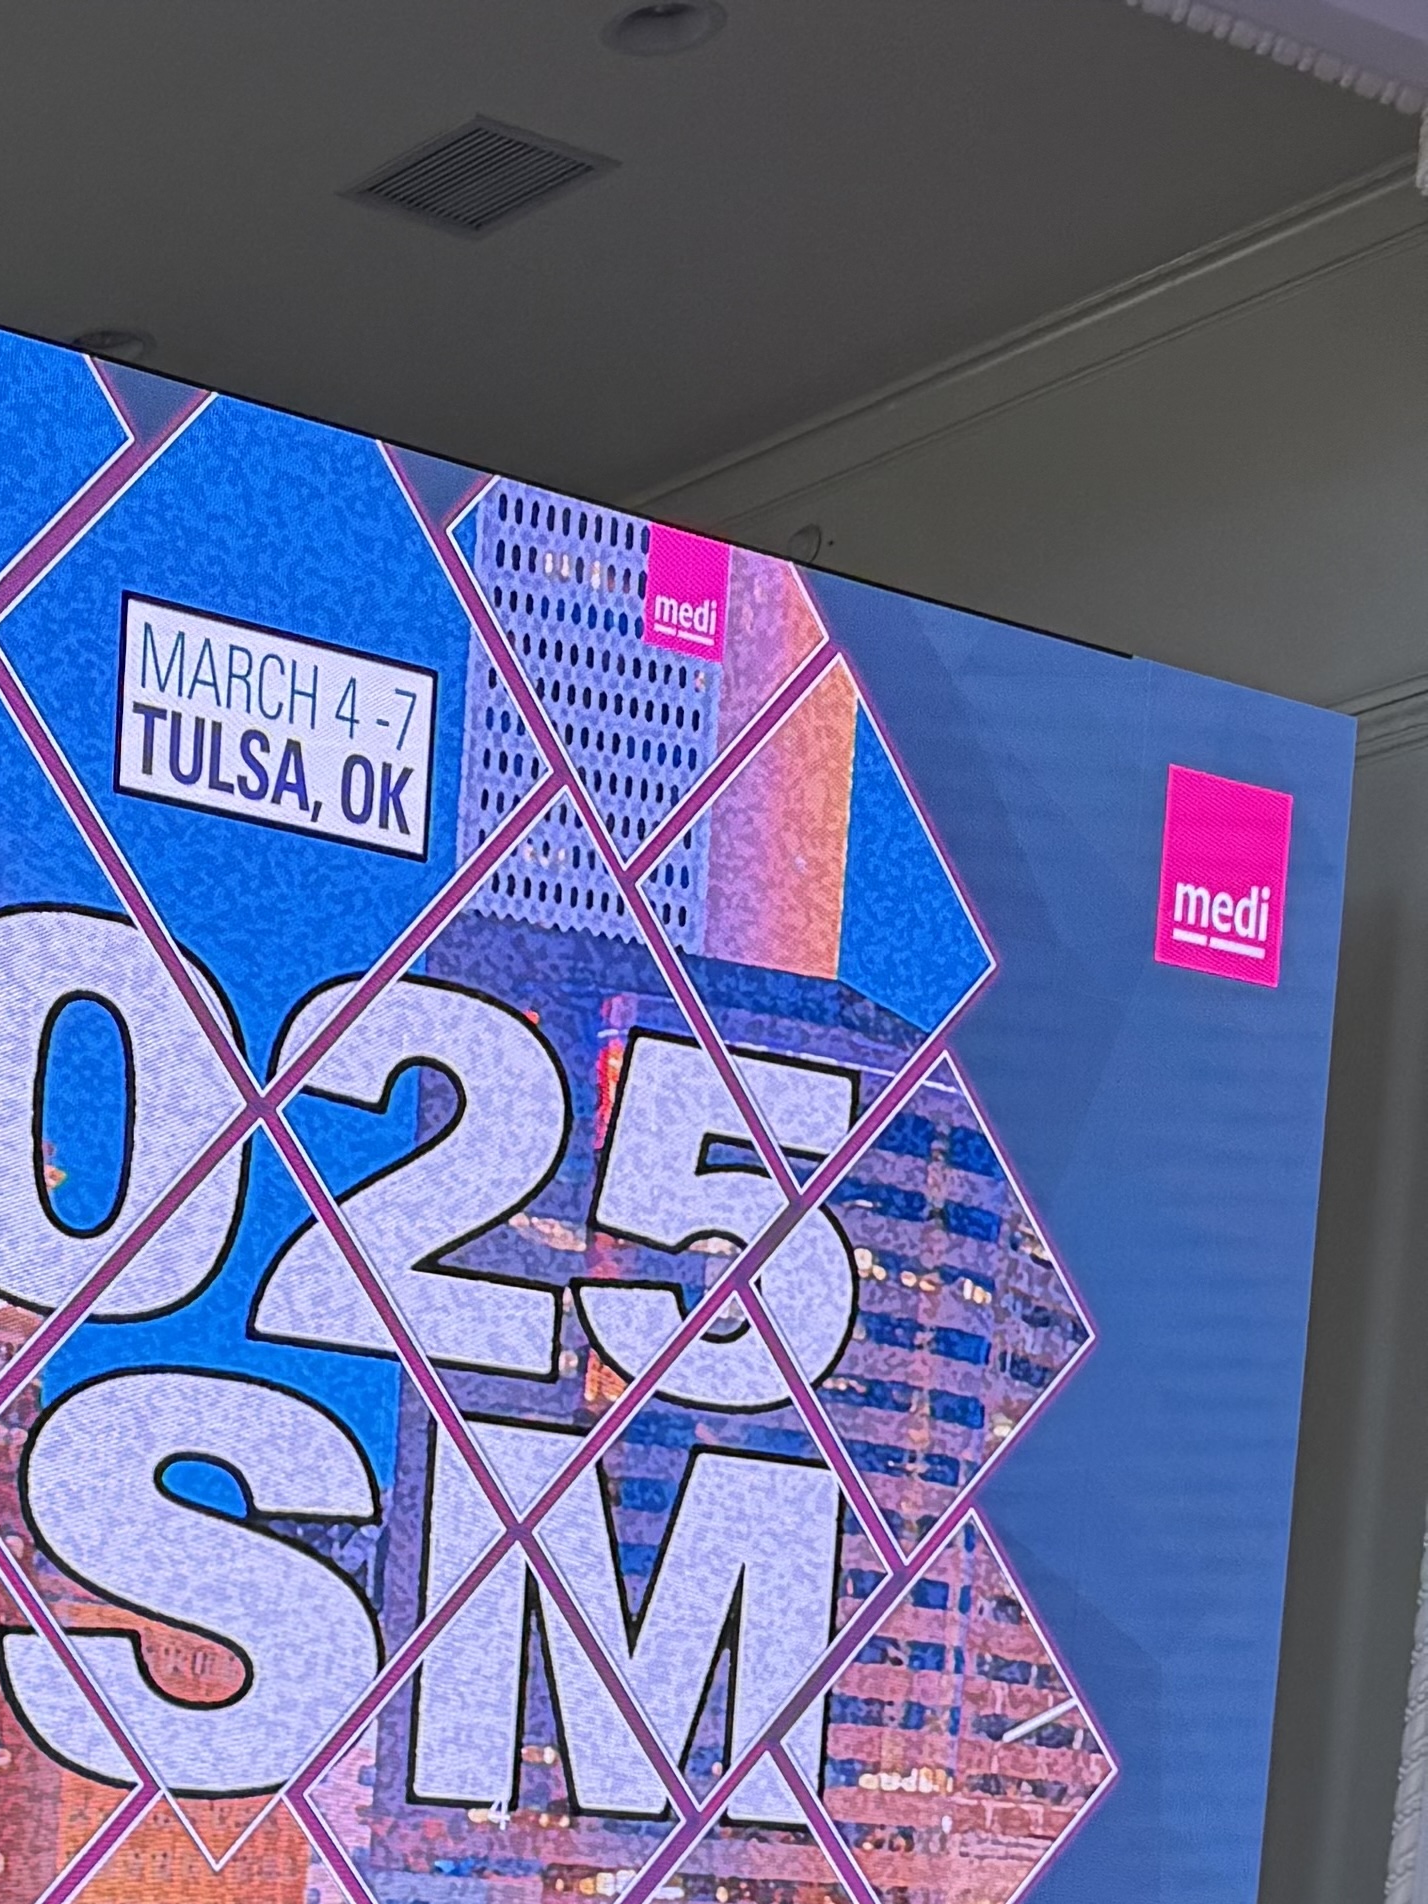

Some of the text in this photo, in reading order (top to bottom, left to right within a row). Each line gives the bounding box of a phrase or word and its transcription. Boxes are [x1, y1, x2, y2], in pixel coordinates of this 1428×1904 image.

[654, 594, 718, 635] medi
[141, 621, 318, 729] MARCH
[335, 676, 360, 739] 4
[132, 701, 414, 835] TULSA, OK
[1174, 881, 1271, 942] medi
